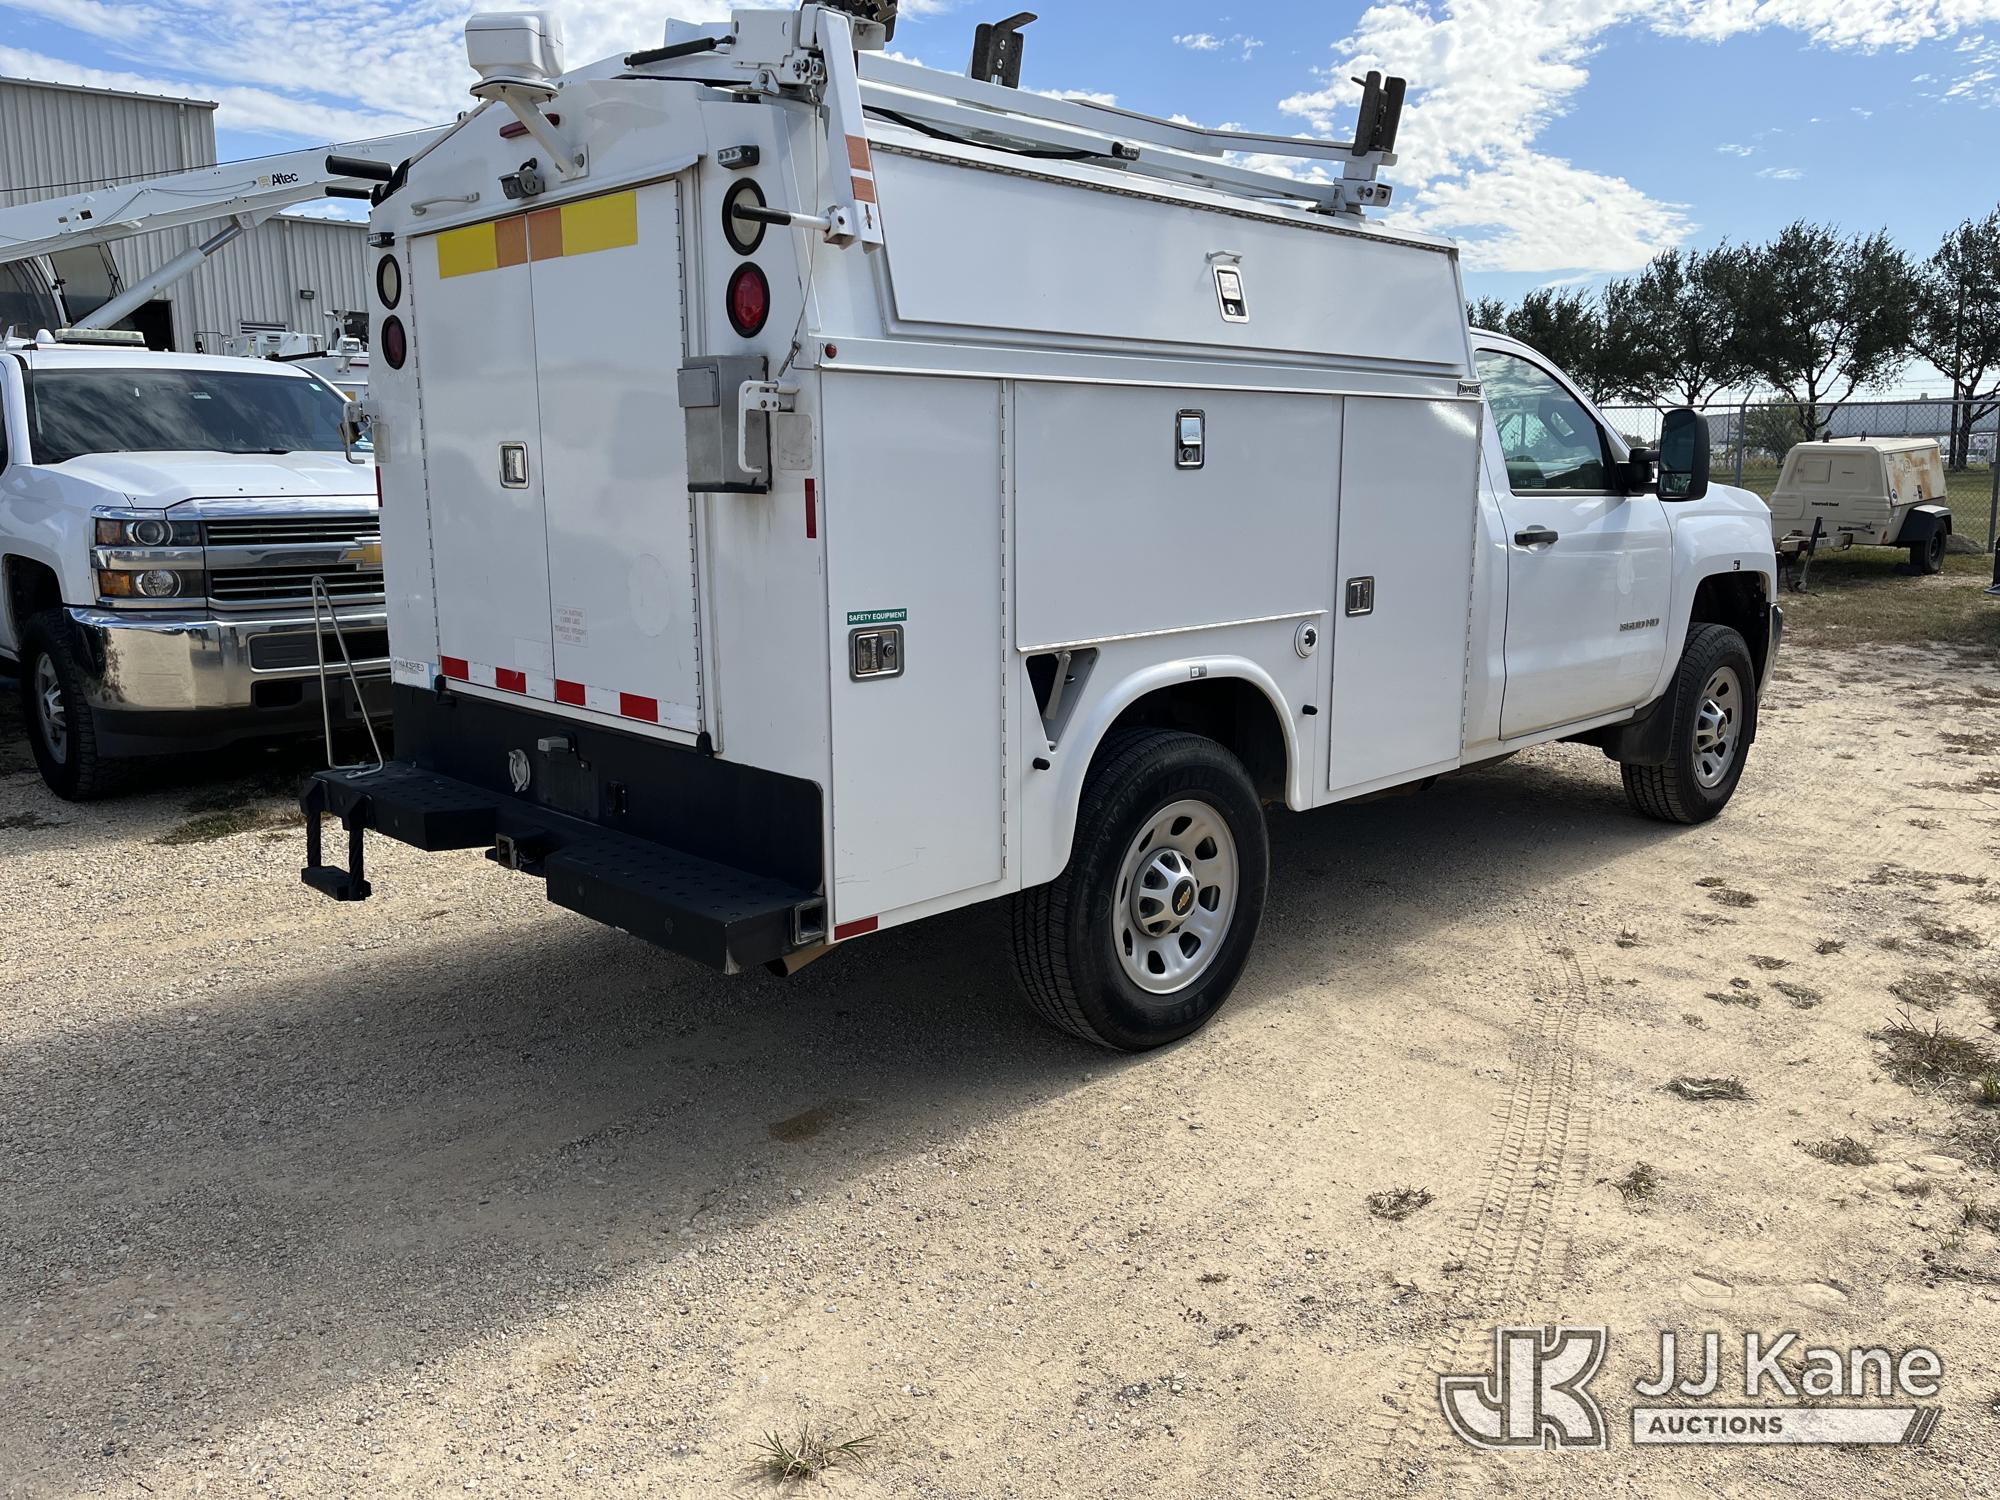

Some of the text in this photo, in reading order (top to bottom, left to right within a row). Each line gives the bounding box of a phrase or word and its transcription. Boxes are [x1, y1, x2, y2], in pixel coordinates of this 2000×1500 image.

[272, 173, 299, 186] Altec
[848, 611, 906, 622] SAFETY EQUIPMENT
